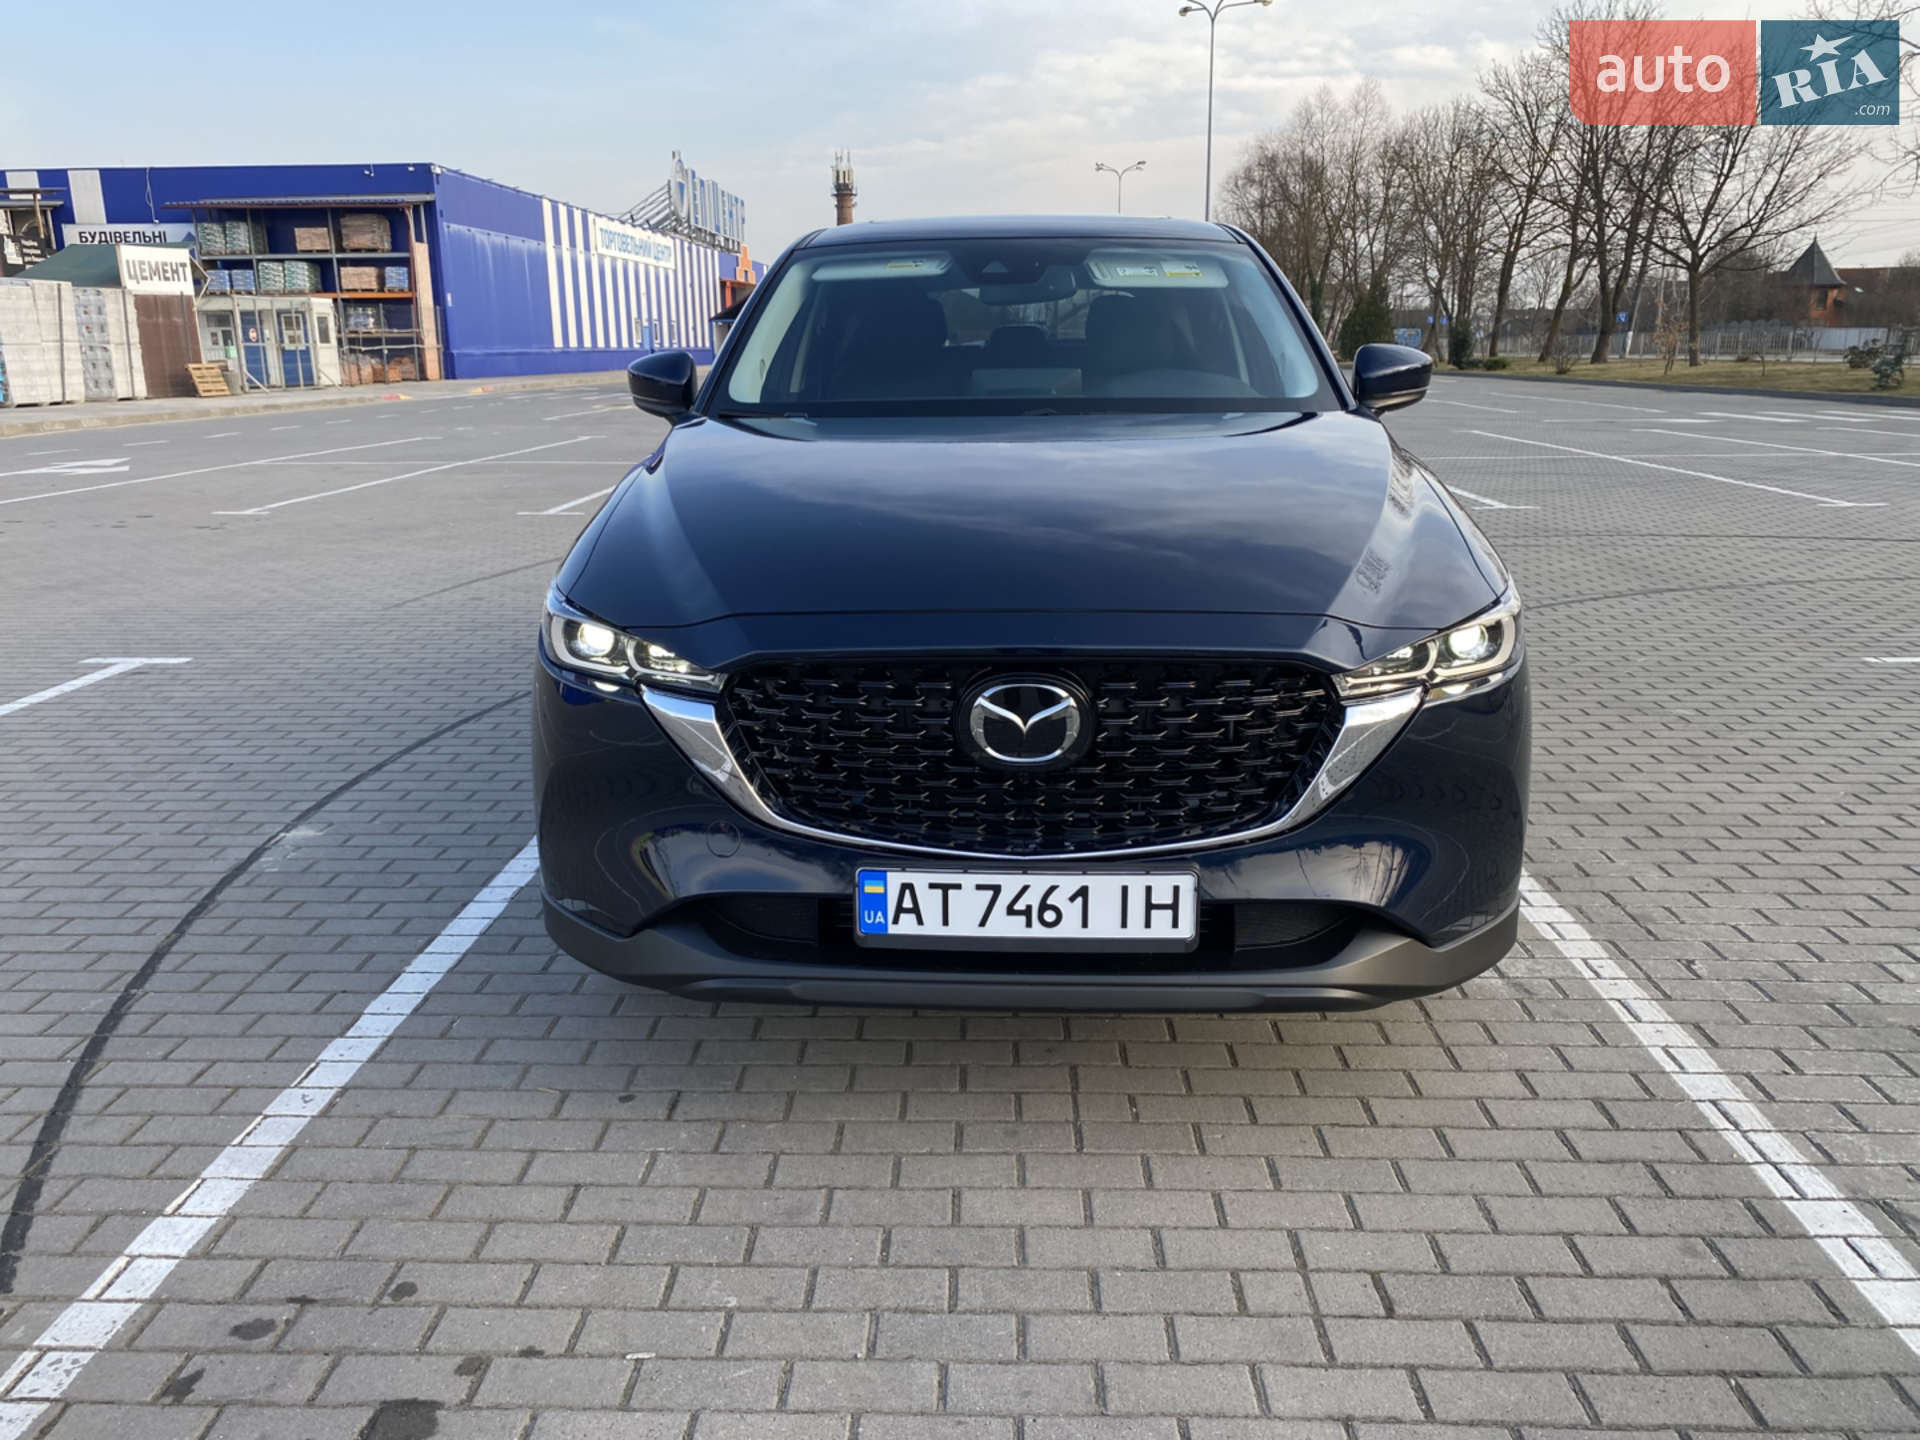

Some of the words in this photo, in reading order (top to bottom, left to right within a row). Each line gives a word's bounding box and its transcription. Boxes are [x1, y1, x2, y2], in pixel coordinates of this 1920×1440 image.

[78, 231, 168, 244] БУДІВЕЛЬНІ
[125, 259, 188, 284] ЦЕМЕНТ
[891, 882, 963, 927] AT
[975, 884, 1089, 929] 7461
[1120, 885, 1181, 929] IH
[864, 910, 885, 924] UA
